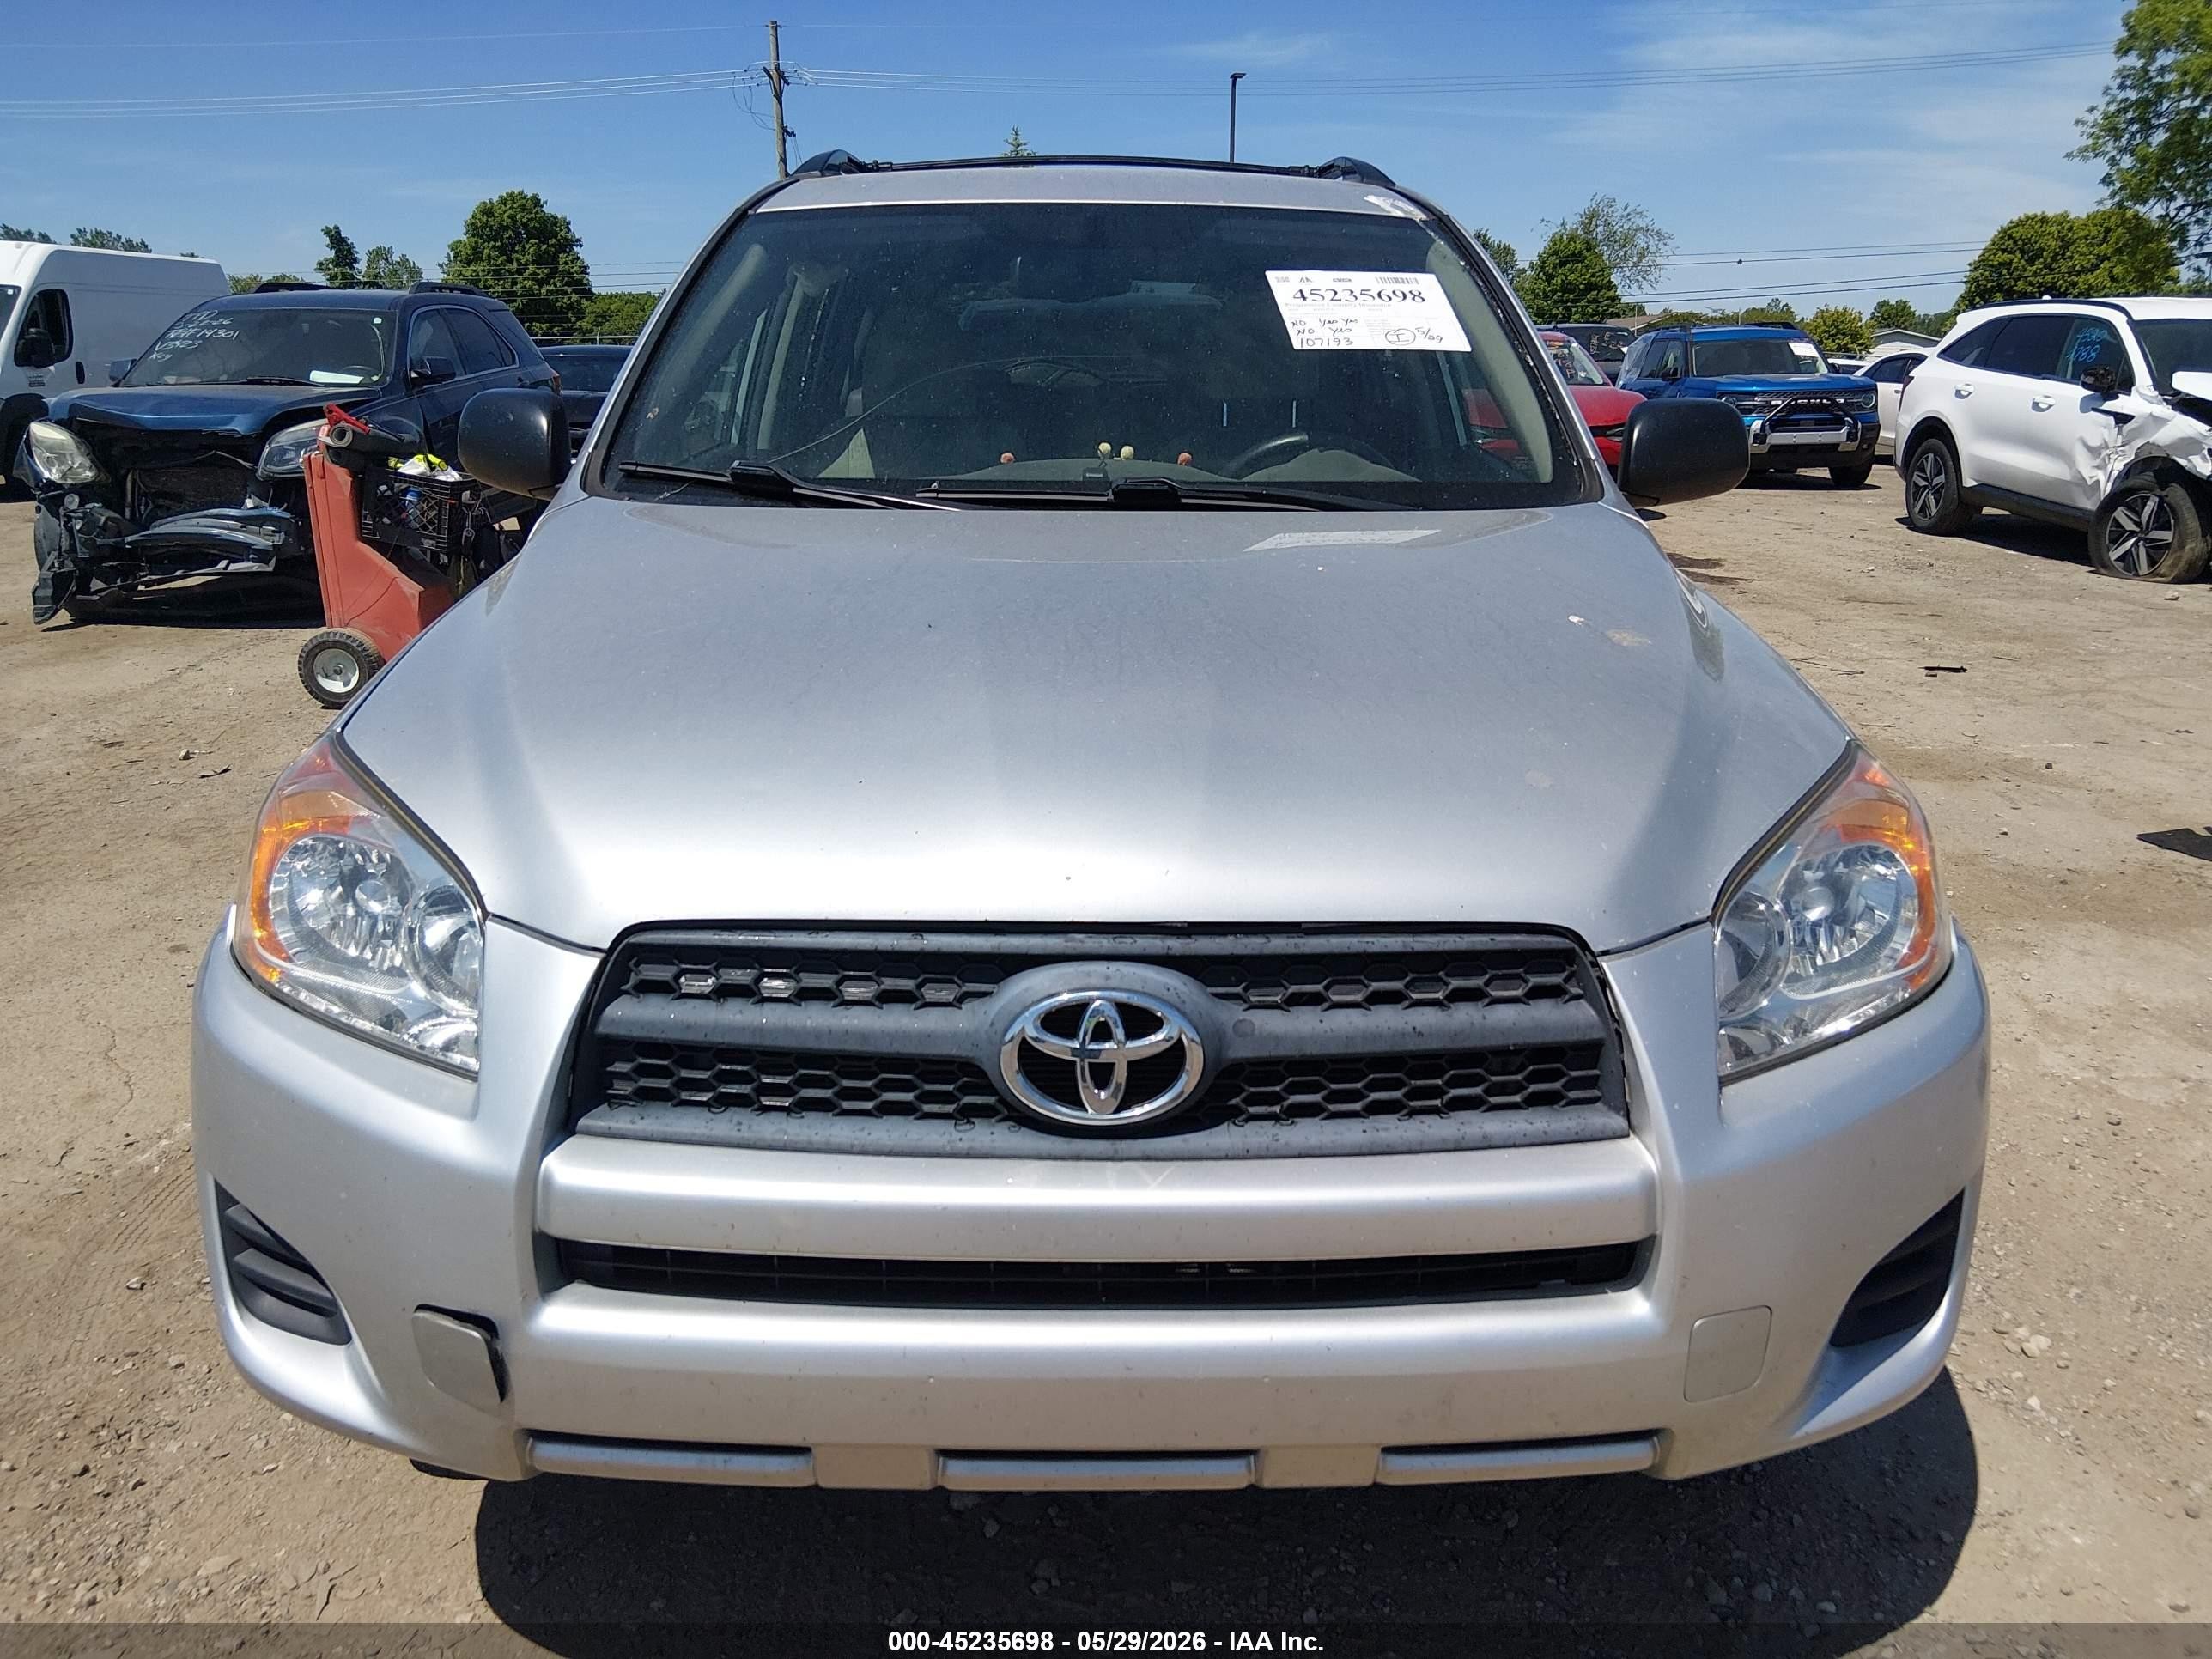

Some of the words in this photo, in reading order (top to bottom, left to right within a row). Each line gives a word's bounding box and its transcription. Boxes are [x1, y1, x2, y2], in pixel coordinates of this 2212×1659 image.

[1292, 288, 1425, 303] 45235698
[1297, 327, 1316, 336] NO
[1300, 337, 1354, 349] 107193
